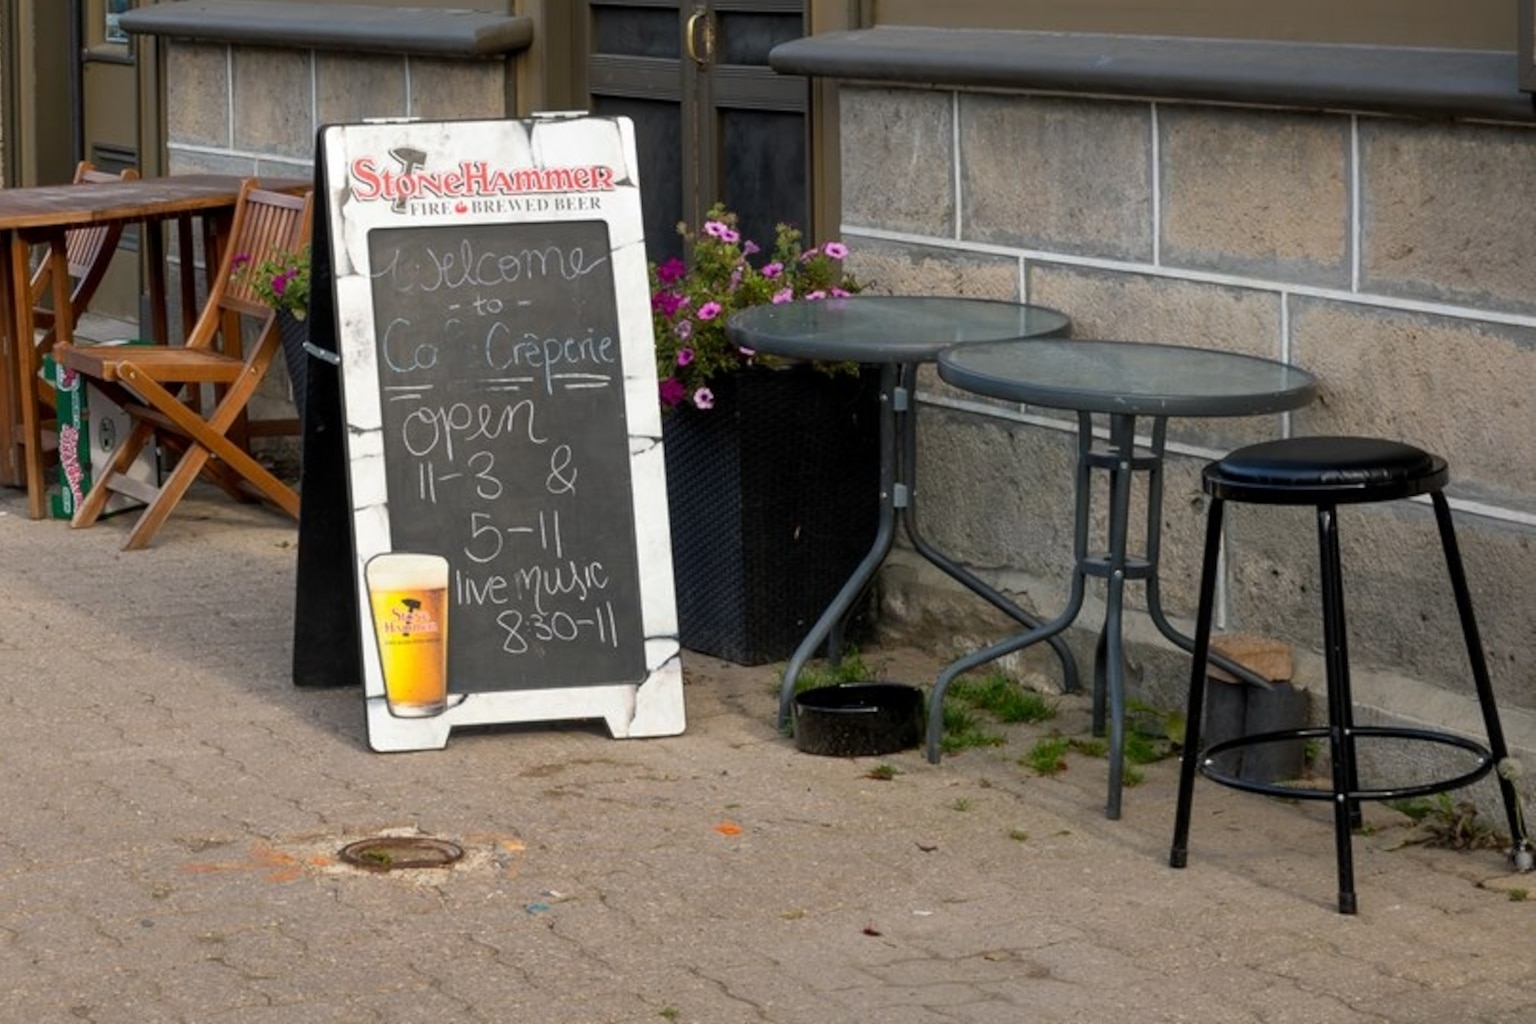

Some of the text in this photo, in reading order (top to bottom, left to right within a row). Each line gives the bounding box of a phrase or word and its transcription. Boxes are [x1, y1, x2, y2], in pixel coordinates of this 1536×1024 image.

[410, 196, 602, 216] FIRE BREWED BEER
[371, 239, 607, 292] Welcome
[403, 399, 547, 461] open
[418, 444, 578, 503] 11-3 &
[464, 510, 563, 563] 5-11
[455, 561, 609, 616] live music
[496, 602, 619, 654] 8:30-11
